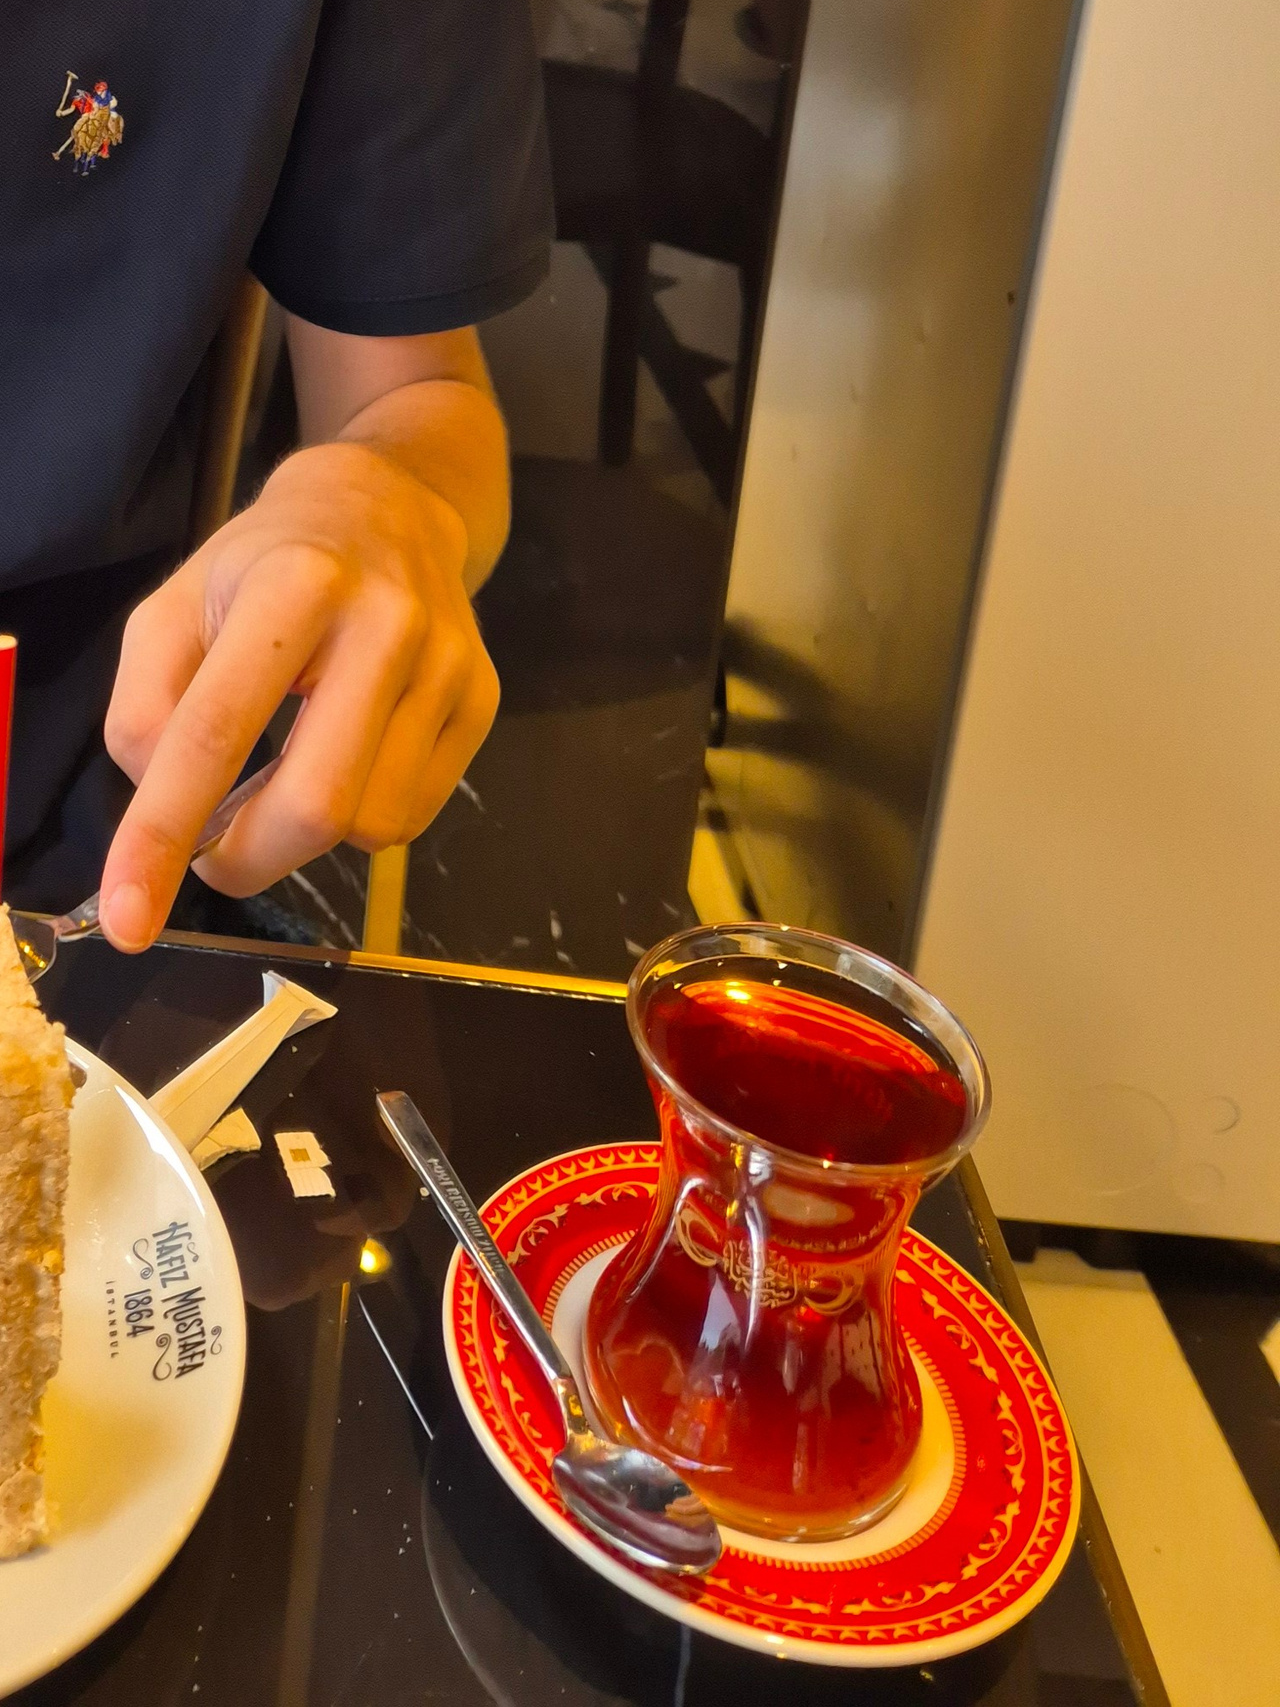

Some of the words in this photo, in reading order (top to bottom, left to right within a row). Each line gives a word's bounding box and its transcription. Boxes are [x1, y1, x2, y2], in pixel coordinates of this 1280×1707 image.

[152, 1221, 193, 1289] HAFIZ
[124, 1288, 155, 1339] 1864
[161, 1286, 207, 1379] MUSTAFA
